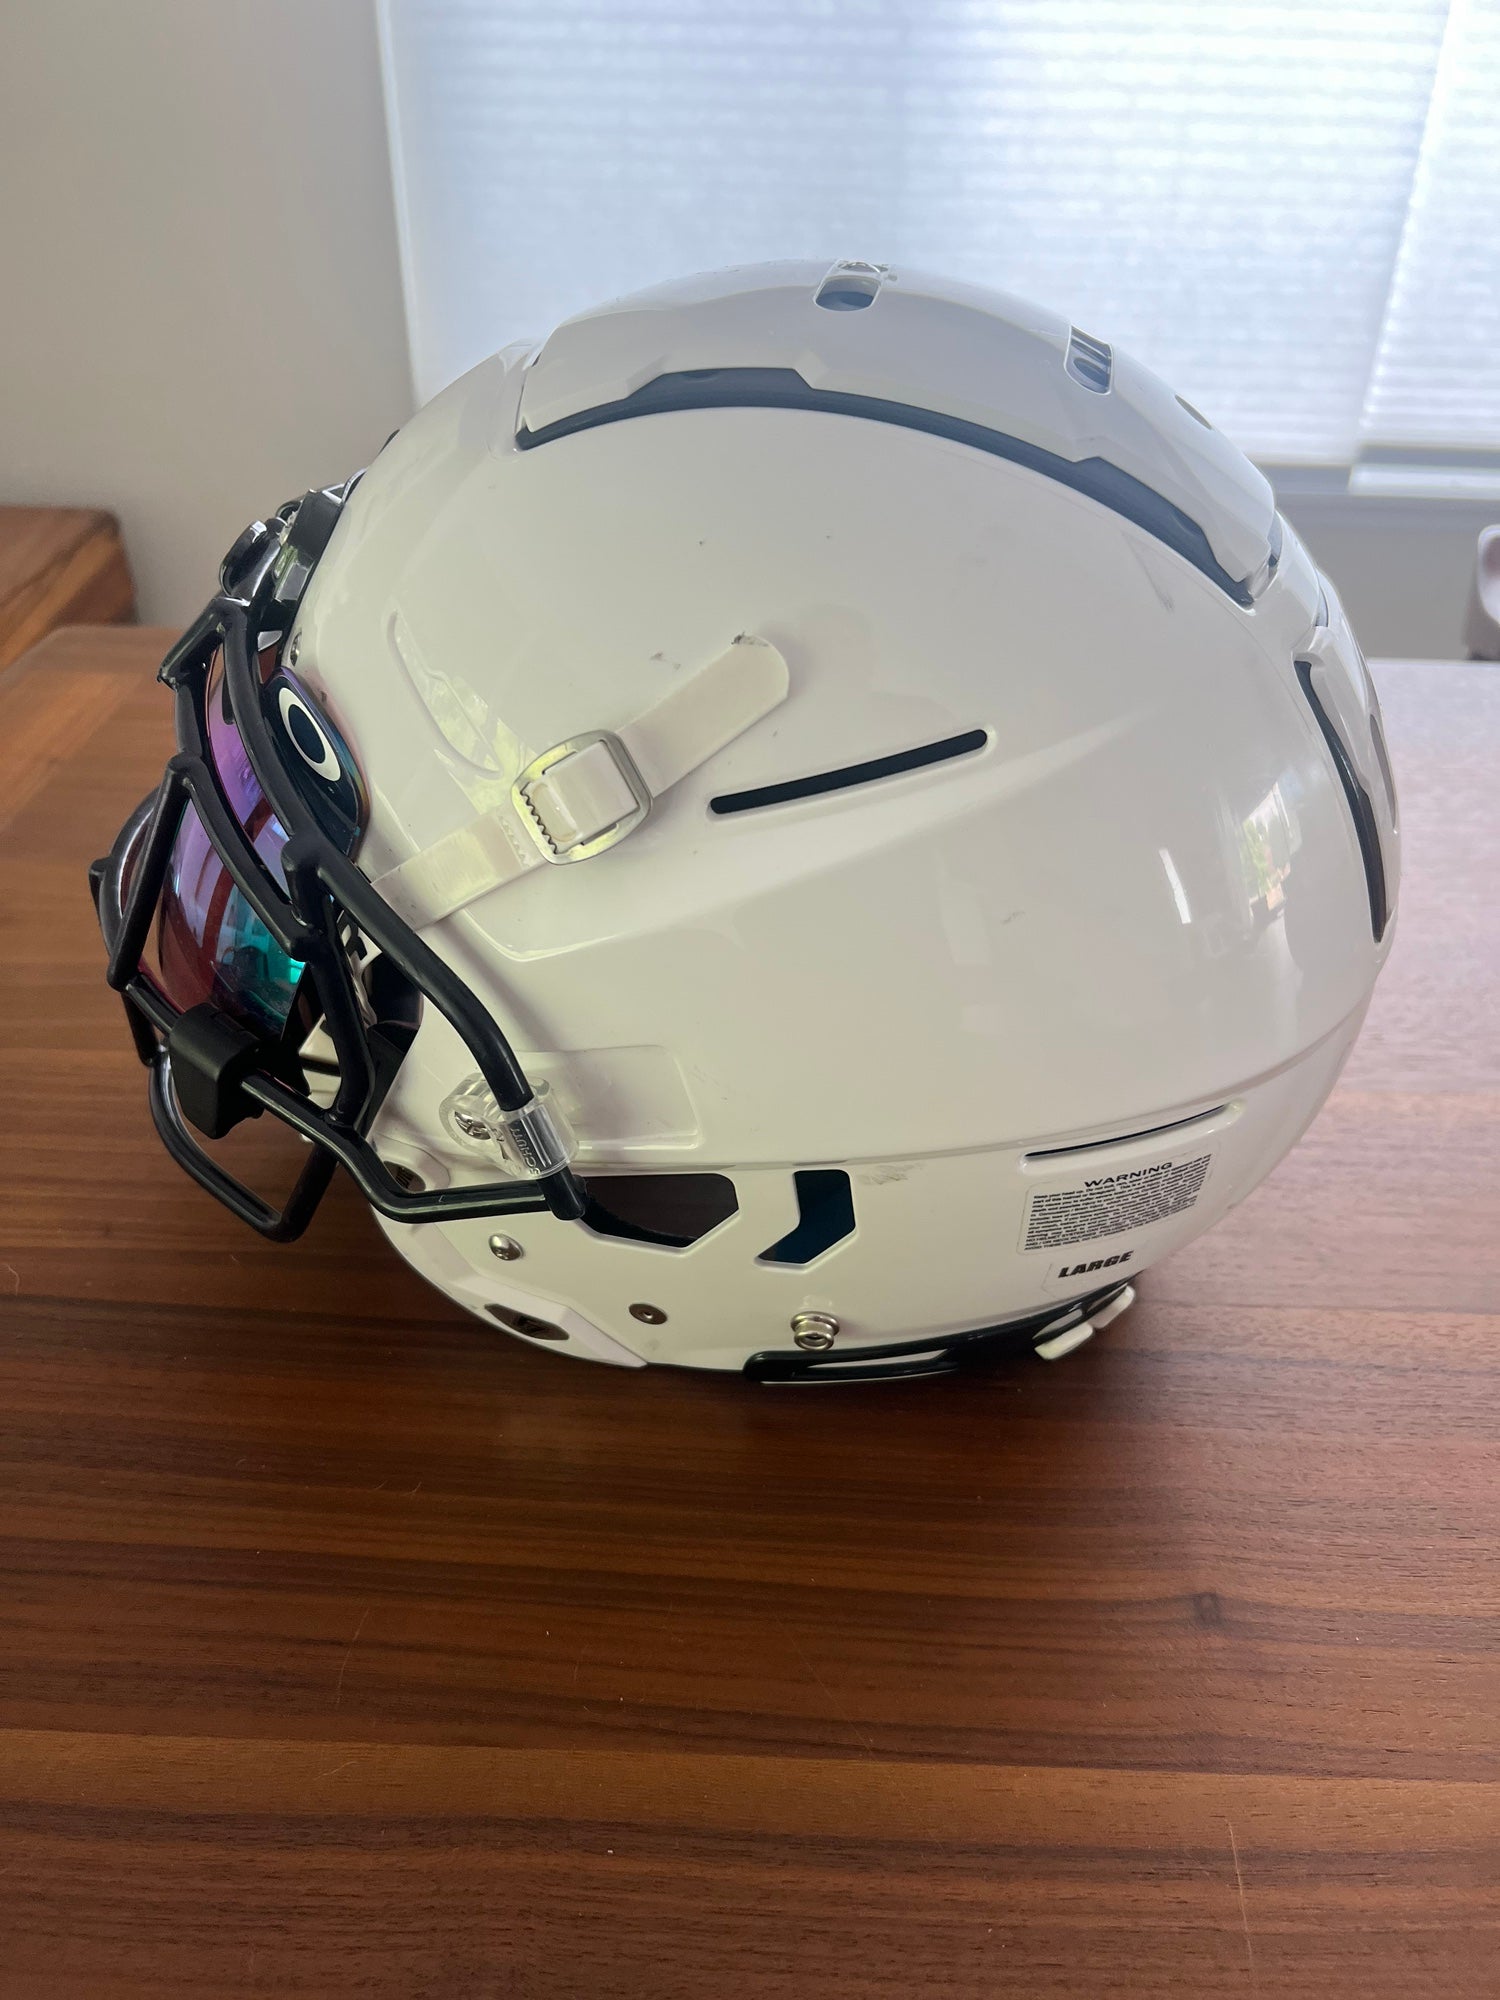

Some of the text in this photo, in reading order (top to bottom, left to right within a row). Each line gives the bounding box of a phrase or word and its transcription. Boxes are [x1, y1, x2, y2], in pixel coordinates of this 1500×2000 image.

[509, 1128, 541, 1176] SCHUTT
[1084, 1162, 1172, 1187] WARNING
[1058, 1250, 1134, 1278] LARGE
